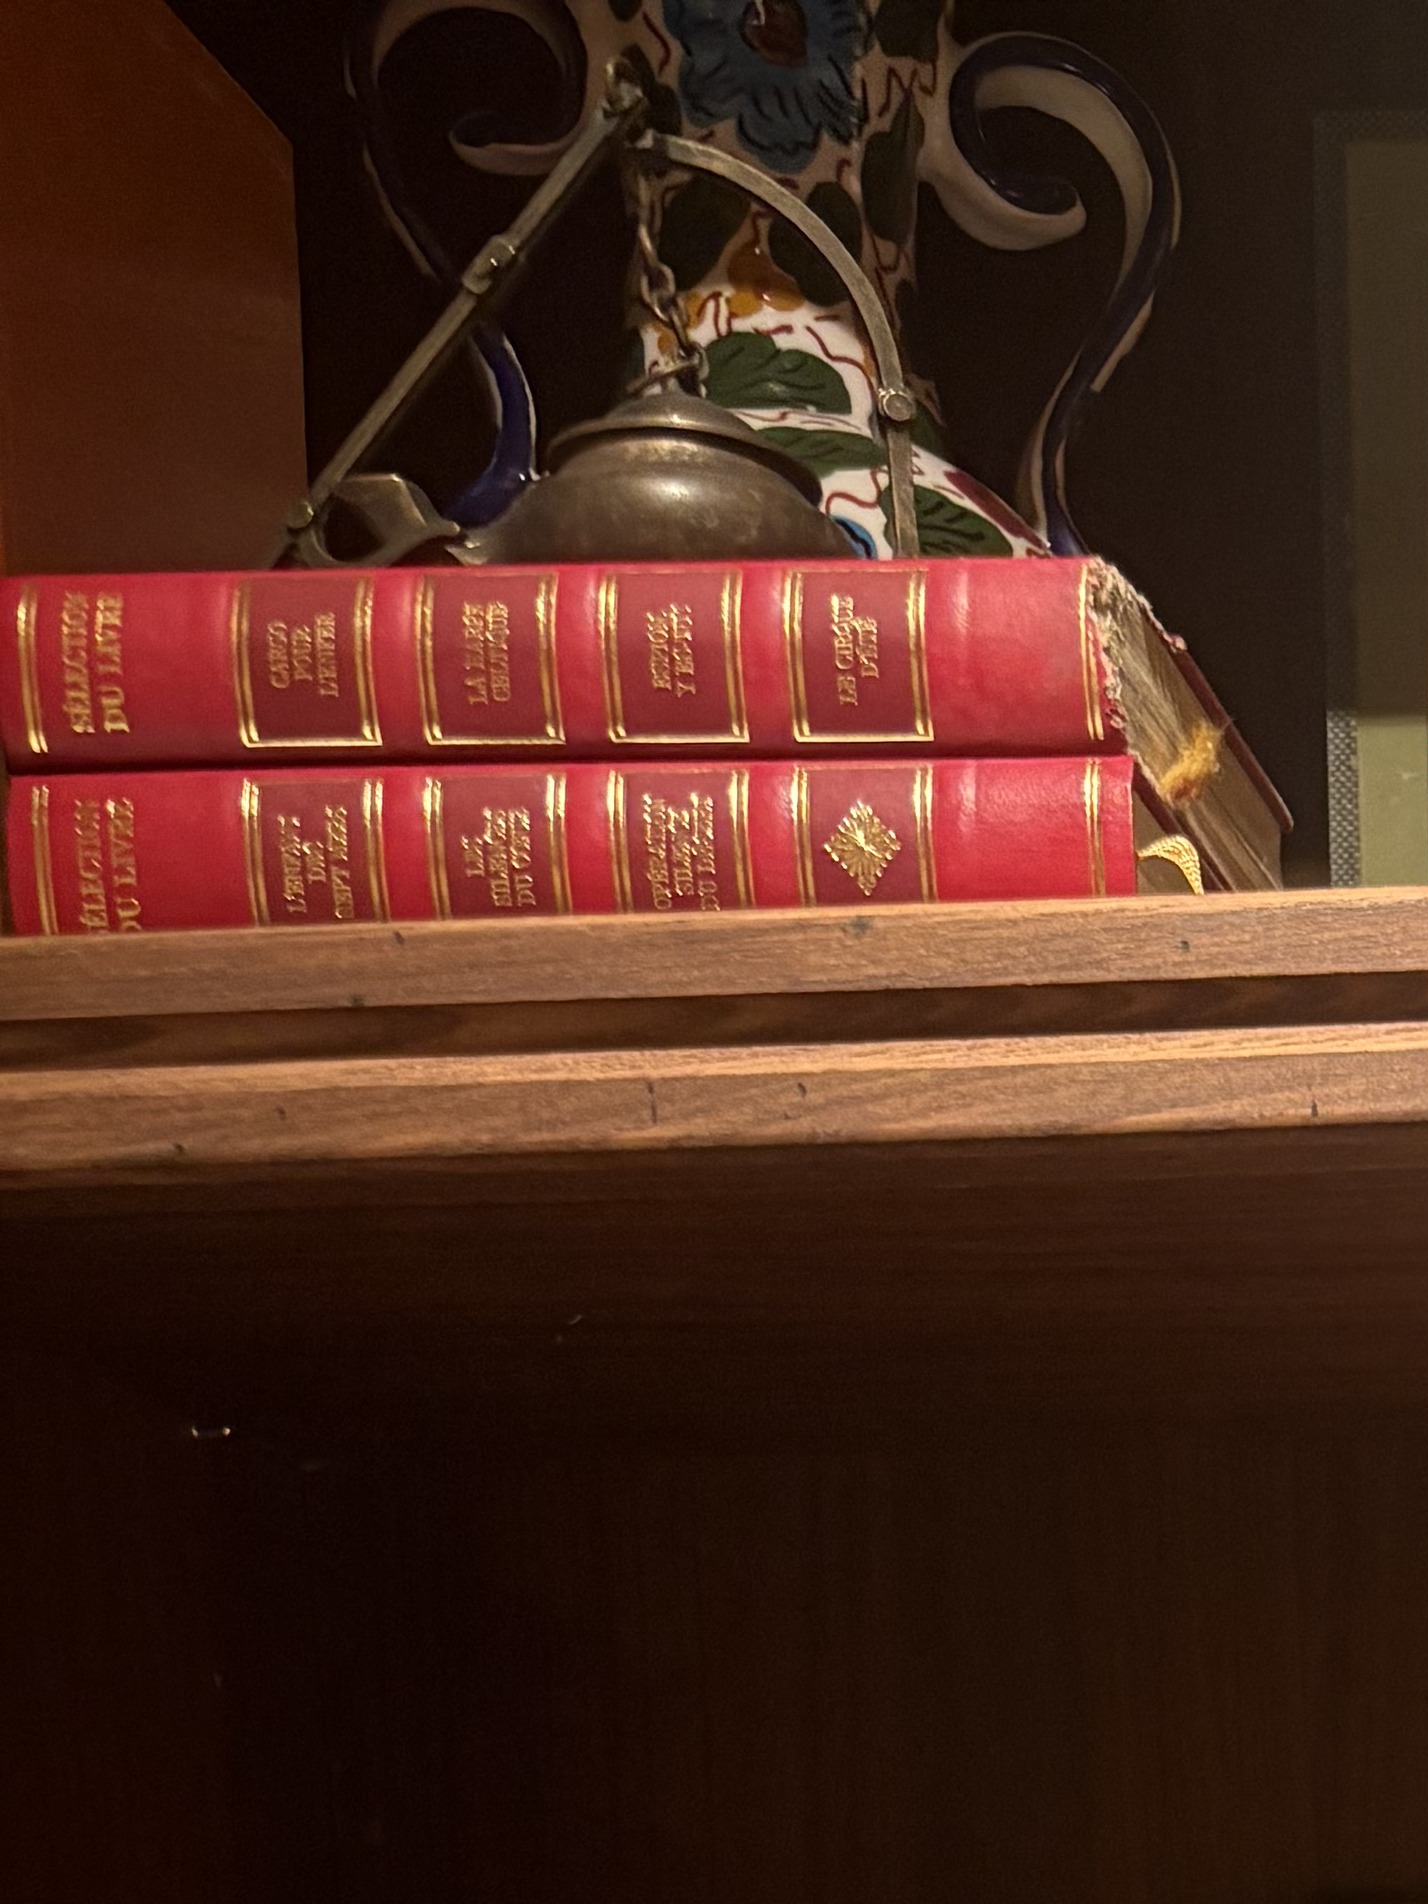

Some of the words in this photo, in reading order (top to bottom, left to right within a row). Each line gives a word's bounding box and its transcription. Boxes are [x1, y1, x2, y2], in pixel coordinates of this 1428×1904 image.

[61, 591, 96, 734] SÉLECTION
[95, 592, 124, 677] LIVRE
[267, 620, 290, 688] CARGO
[829, 593, 854, 670] CIRQUE
[100, 686, 130, 734] DU
[836, 676, 858, 706] LE
[106, 797, 138, 886] LIVRE
